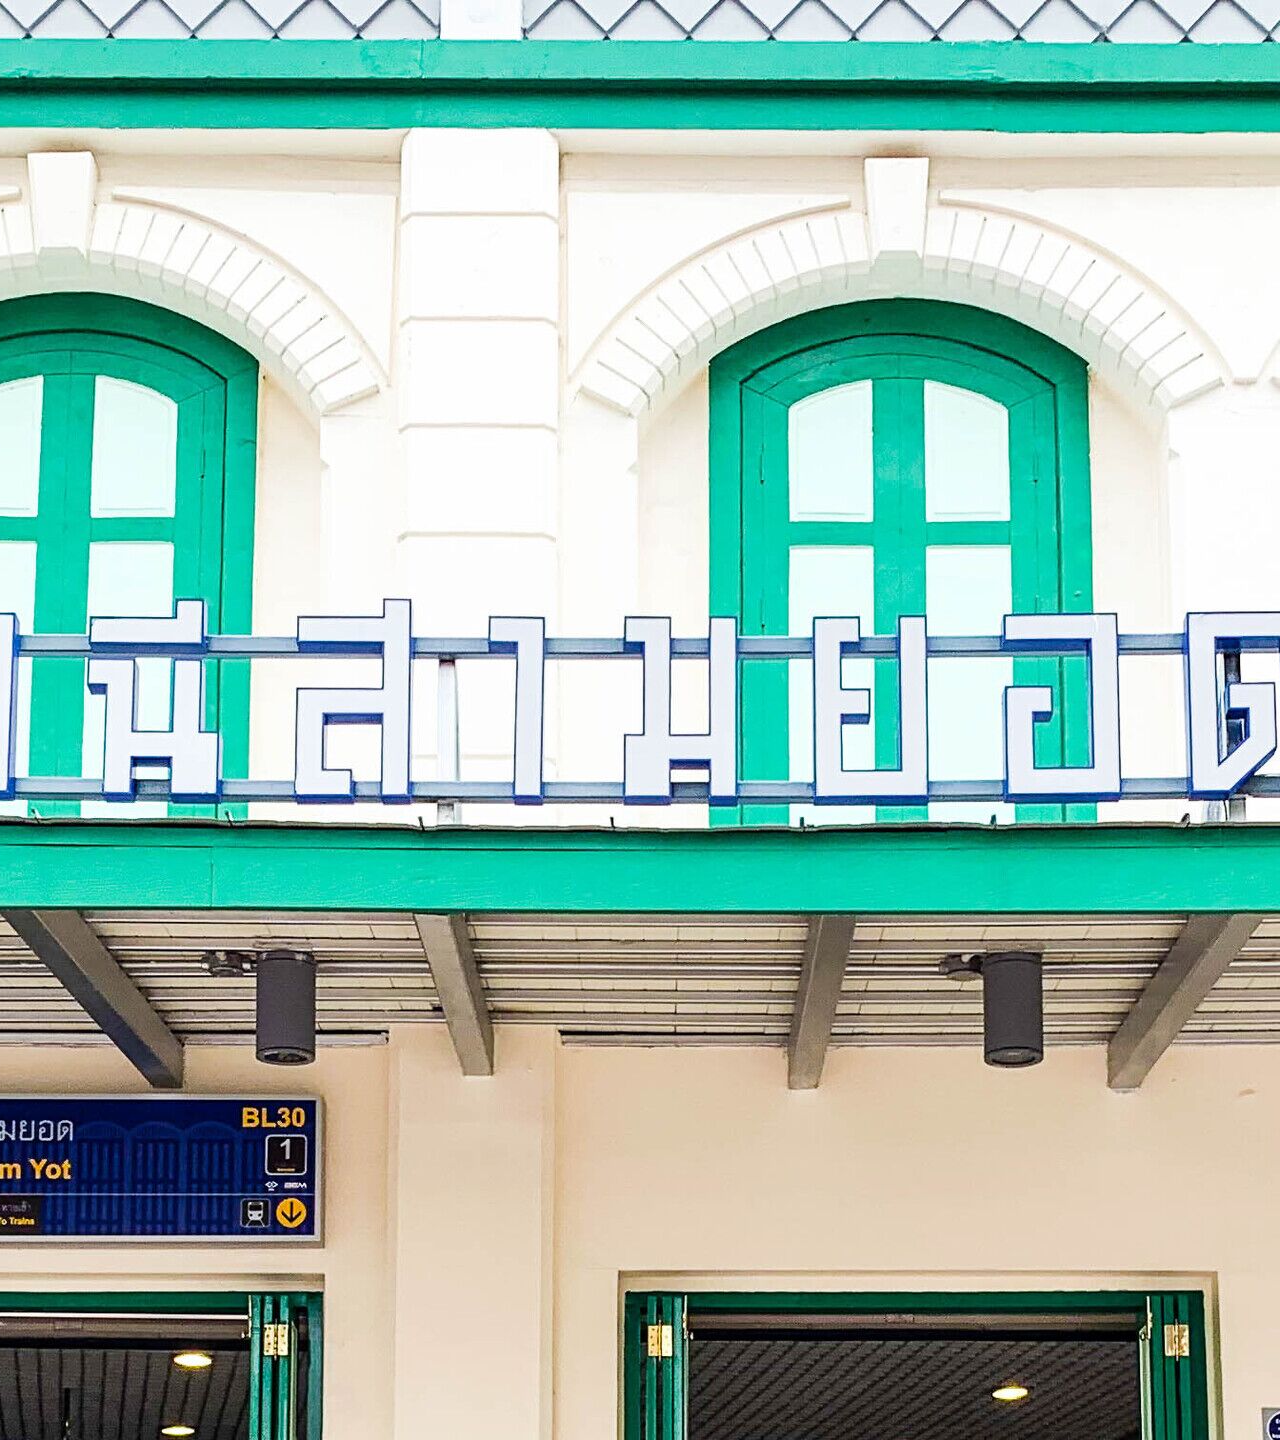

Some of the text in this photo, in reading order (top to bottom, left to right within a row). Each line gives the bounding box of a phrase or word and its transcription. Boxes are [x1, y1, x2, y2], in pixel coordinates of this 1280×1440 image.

[242, 1106, 306, 1129] BL30
[279, 1138, 291, 1160] 1
[28, 1157, 72, 1180] Yot
[9, 1216, 35, 1226] Trains
